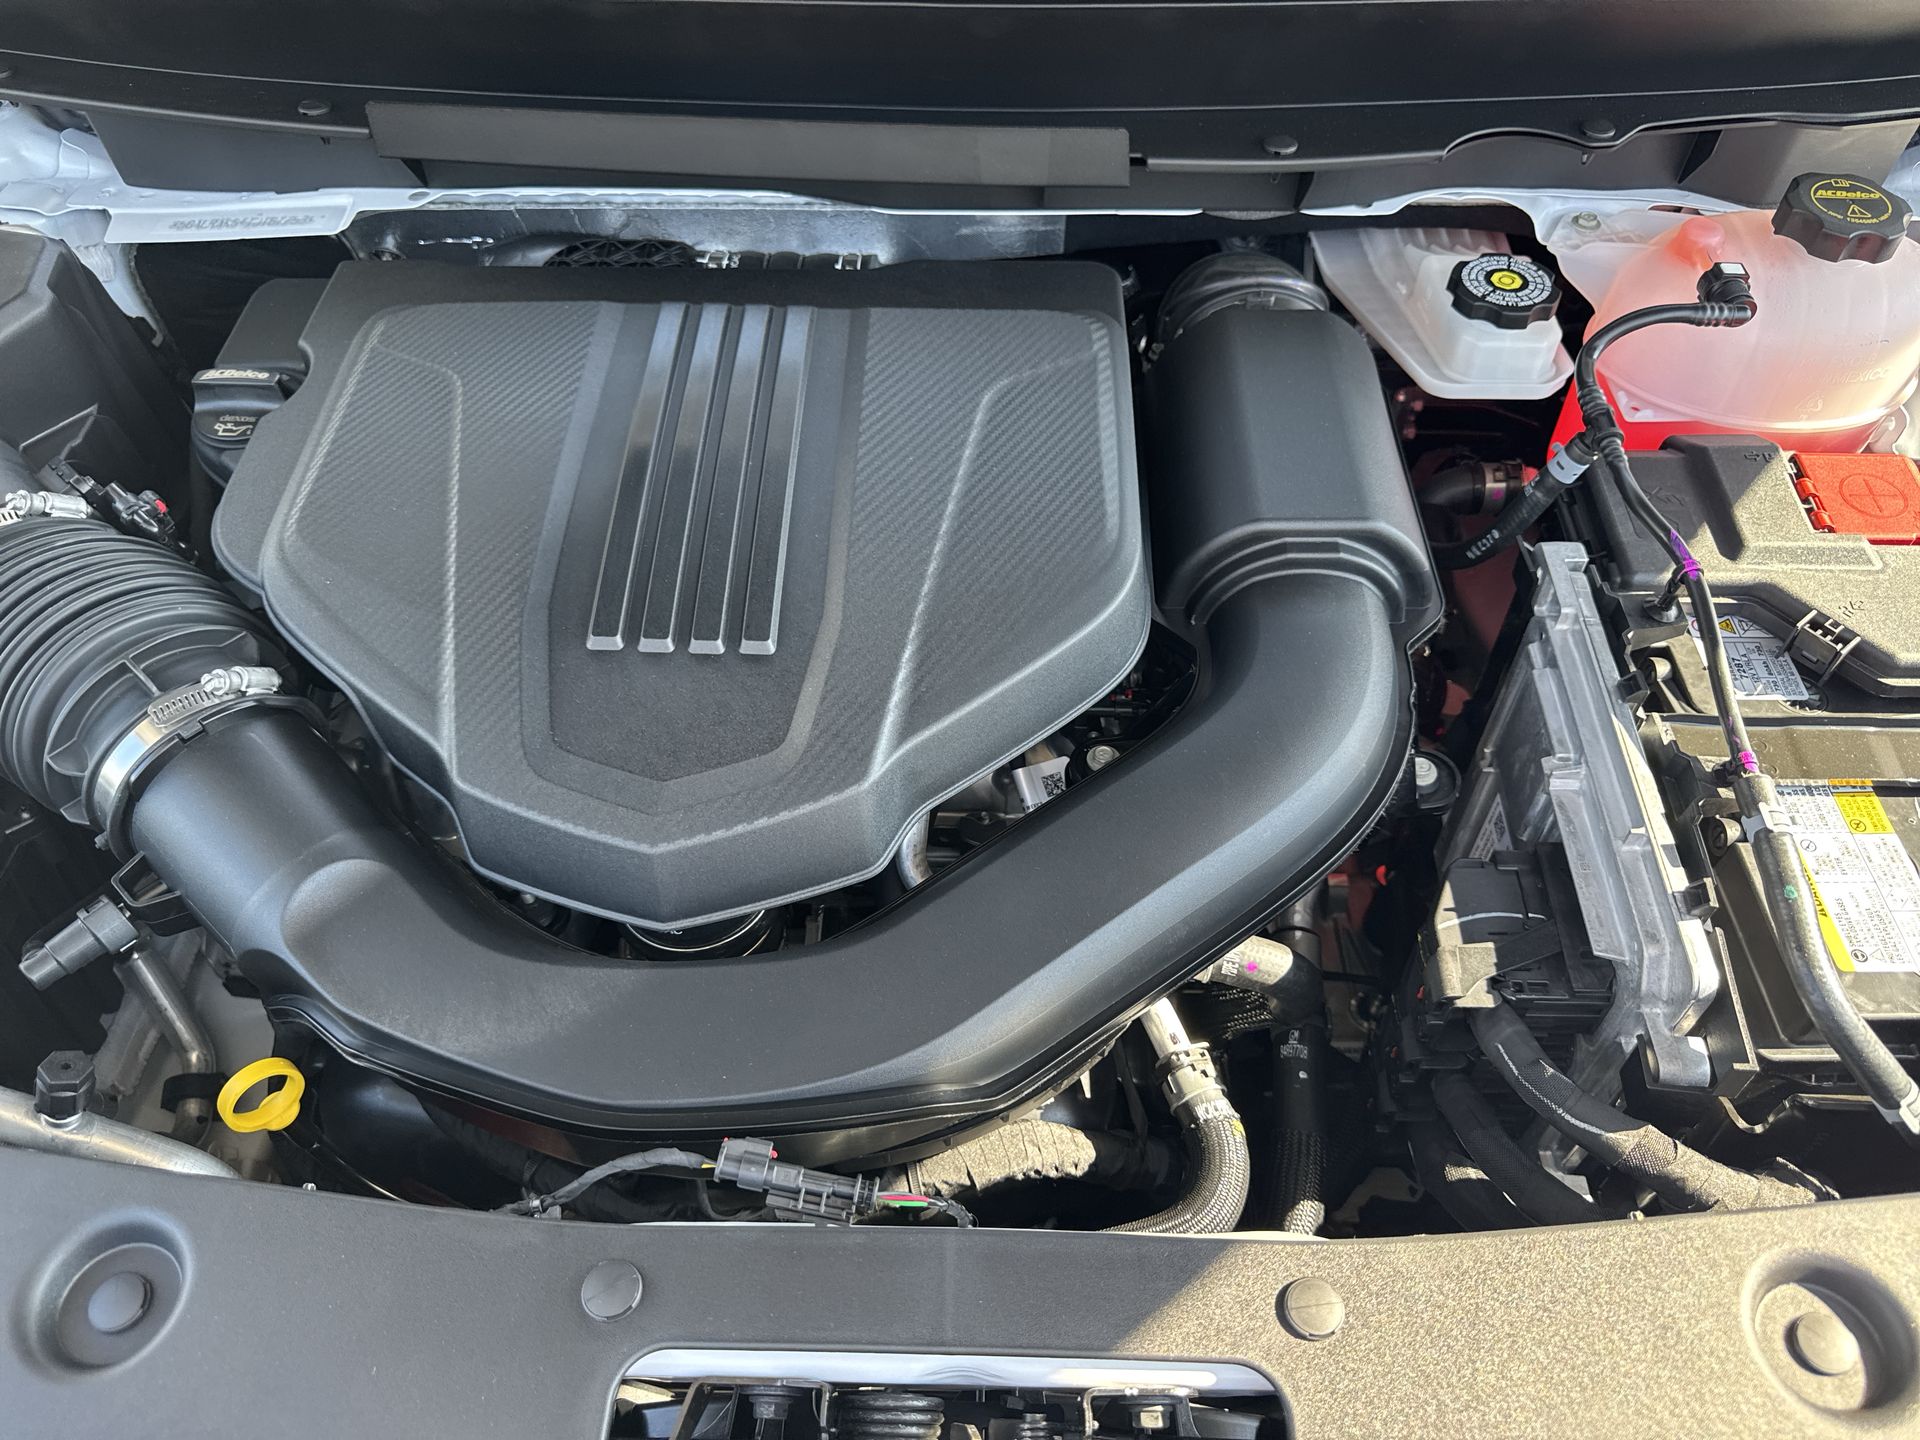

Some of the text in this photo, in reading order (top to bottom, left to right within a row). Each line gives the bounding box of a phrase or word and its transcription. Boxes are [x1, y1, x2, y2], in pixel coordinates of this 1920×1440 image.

[1815, 189, 1881, 199] ACDelco
[202, 368, 271, 380] ACDelco
[1731, 657, 1750, 680] 7287
